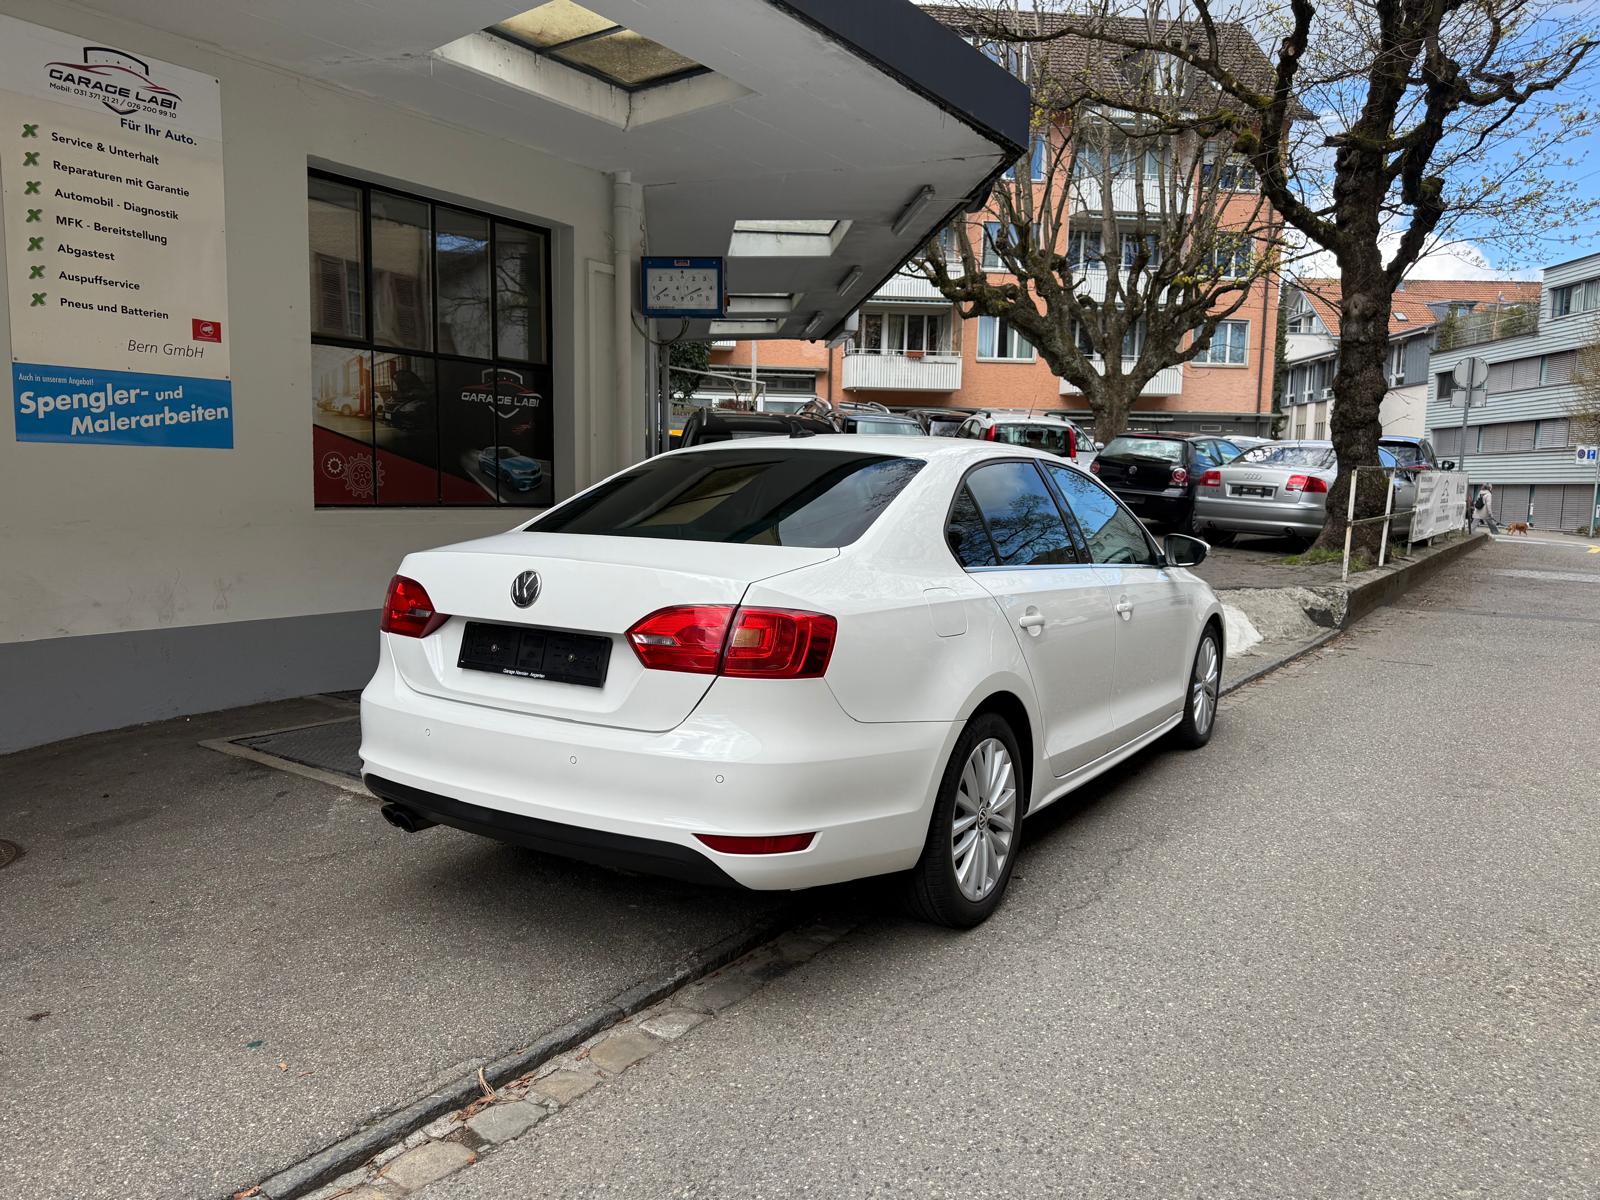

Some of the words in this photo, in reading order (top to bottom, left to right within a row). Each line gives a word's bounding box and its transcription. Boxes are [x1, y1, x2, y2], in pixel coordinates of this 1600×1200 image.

[49, 69, 130, 98] GARAGE
[136, 92, 177, 110] LABI
[50, 82, 72, 94] Mobil:
[74, 88, 87, 97] 031
[88, 92, 101, 100] 371
[112, 96, 119, 104] 21
[127, 101, 141, 110] 076
[142, 104, 156, 114] 200
[158, 108, 168, 116] 99
[120, 118, 141, 132] Für
[145, 125, 161, 137] Ihr
[165, 130, 198, 146] Auto.
[51, 132, 93, 150] Service
[97, 142, 105, 152] &
[109, 146, 160, 166] Unterhalt
[53, 160, 122, 183] Reparaturen
[126, 176, 143, 188] mit
[146, 180, 190, 197] Garantie
[54, 188, 114, 208] Automobil
[123, 202, 178, 220] Diagnostik
[56, 216, 84, 228] MFK
[94, 222, 168, 246] Bereitstellung
[57, 244, 116, 261] Abgastest
[59, 271, 140, 291] Auspuffservice
[60, 298, 94, 310] Pneus
[97, 304, 118, 313] und
[121, 305, 169, 320] Batterien
[128, 340, 158, 354] Bern
[163, 343, 204, 358] GmbH
[18, 372, 34, 382] Auch
[34, 374, 41, 382] in
[42, 375, 68, 384] unserem
[20, 383, 149, 418] Spengler-
[155, 386, 183, 400] und
[461, 392, 512, 405] GARAGE
[514, 397, 540, 407] LABI
[71, 404, 229, 436] Malerarbeiten
